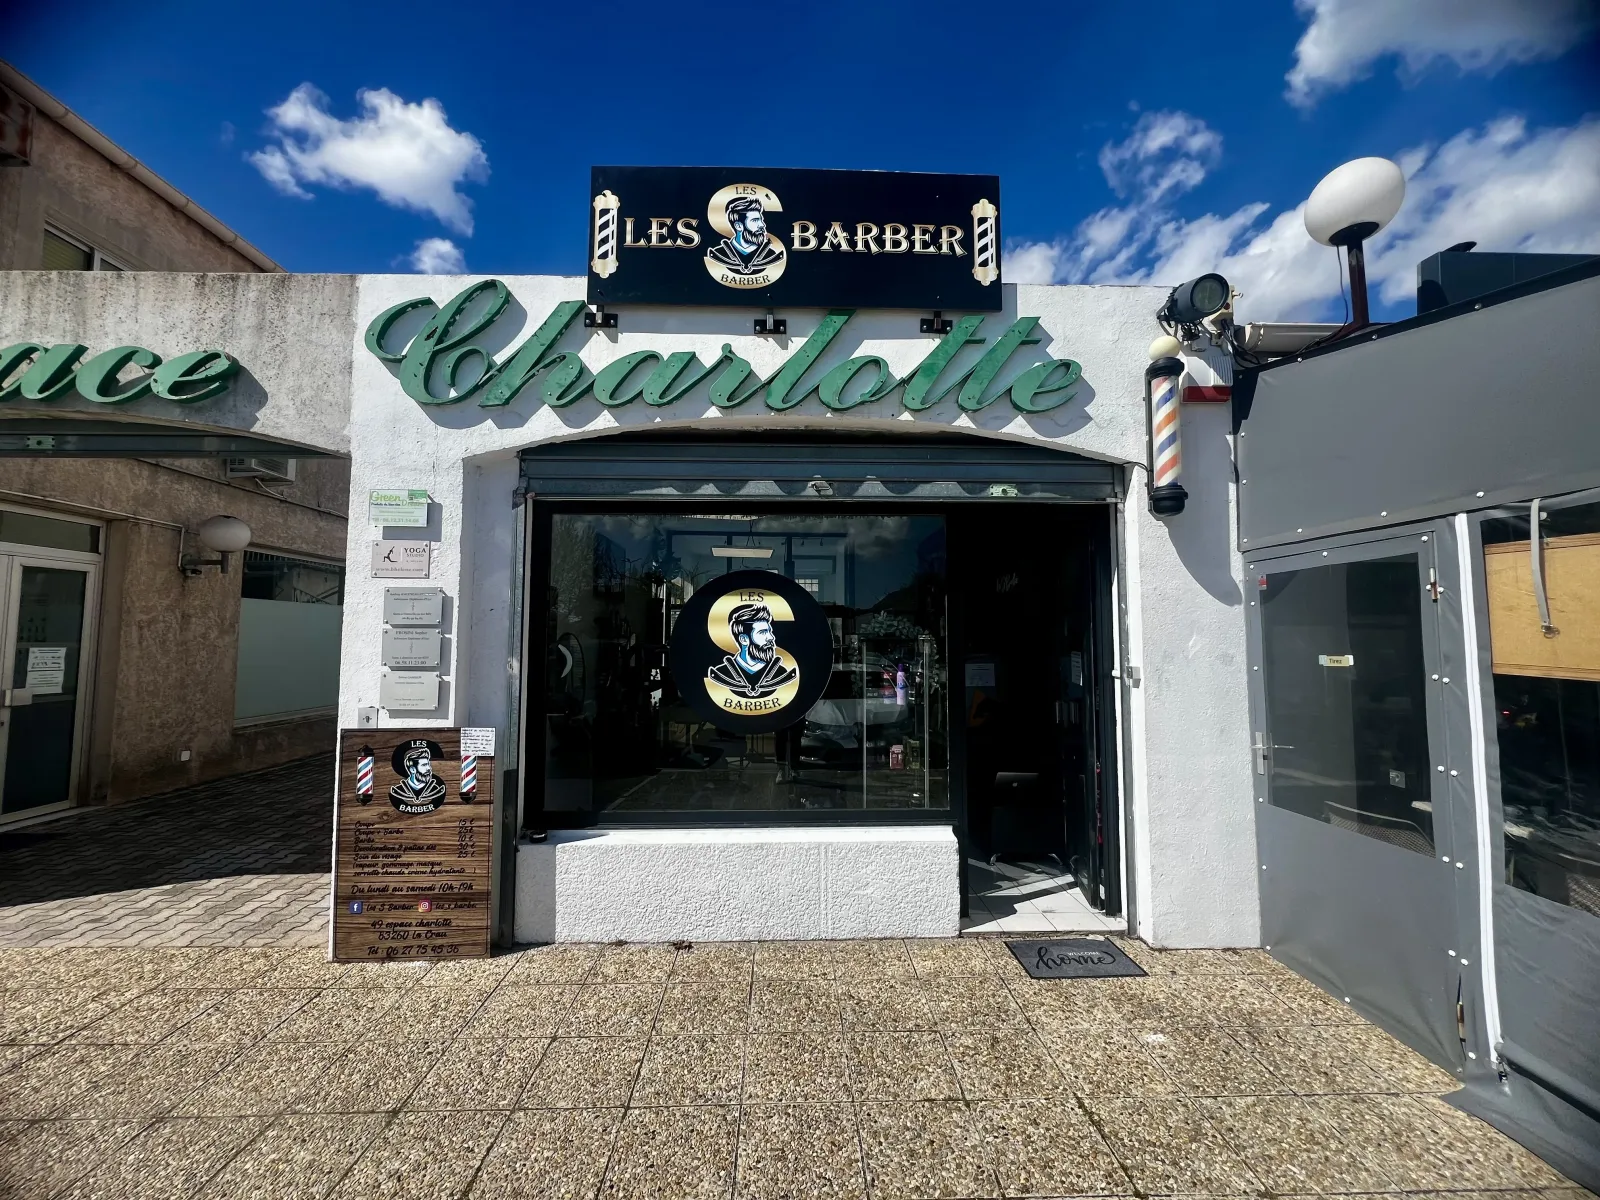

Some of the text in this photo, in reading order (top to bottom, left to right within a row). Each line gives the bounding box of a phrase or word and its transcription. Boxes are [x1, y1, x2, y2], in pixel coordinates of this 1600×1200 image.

[736, 186, 757, 196] LES
[623, 216, 701, 249] LES
[791, 220, 968, 258] BARBER
[720, 274, 770, 286] BARBER
[364, 278, 1083, 415] Charlotte
[740, 592, 764, 602] LES
[724, 698, 782, 712] BARBER
[411, 740, 427, 748] LES
[399, 804, 434, 812] BARBER
[458, 818, 467, 826] 15
[354, 828, 375, 836] Coupe
[458, 834, 466, 842] 10
[351, 885, 364, 894] Du
[366, 884, 389, 892] lundi
[406, 884, 436, 892] samedi
[379, 904, 385, 912] S
[370, 919, 452, 932] 49 espace charlotte
[424, 930, 447, 939] Crau
[386, 946, 398, 956] 06
[401, 945, 413, 954] 27
[416, 944, 428, 954] 75
[430, 945, 444, 954] 45
[1036, 946, 1116, 970] home
